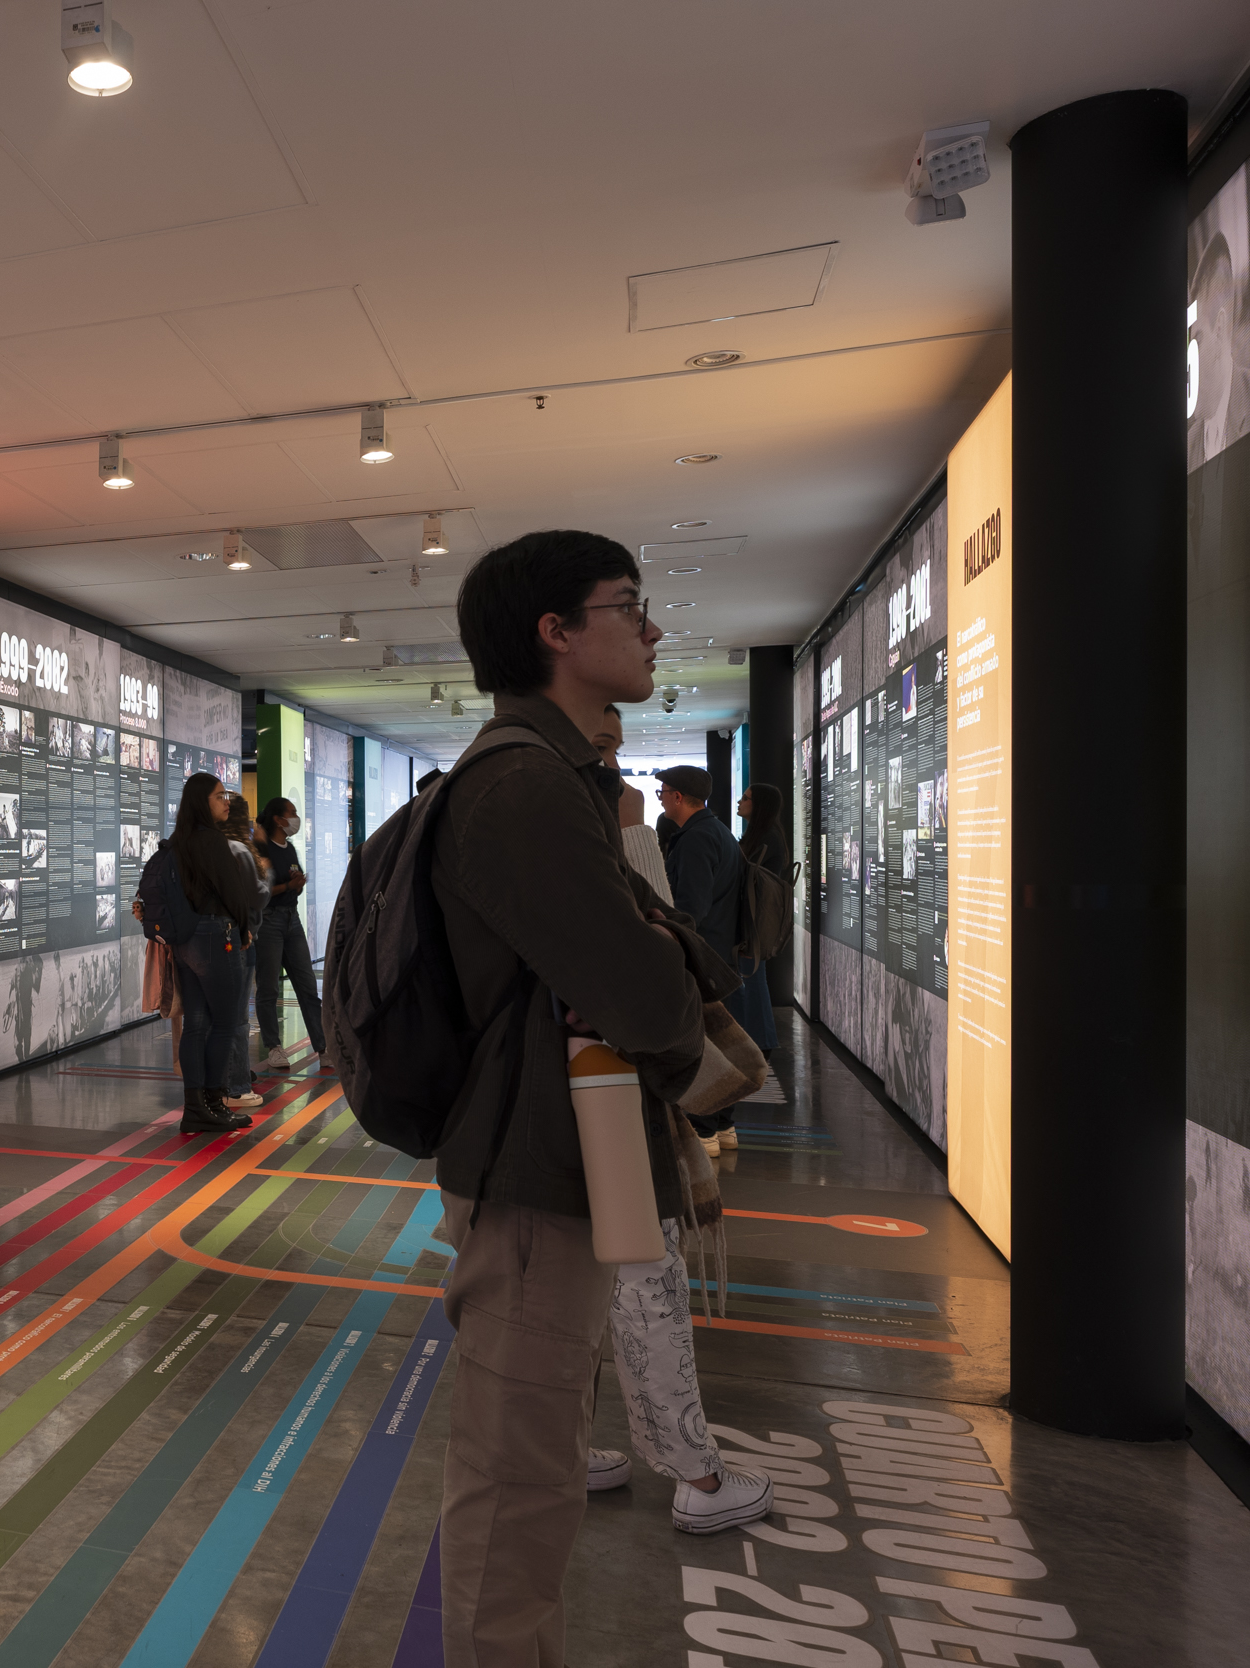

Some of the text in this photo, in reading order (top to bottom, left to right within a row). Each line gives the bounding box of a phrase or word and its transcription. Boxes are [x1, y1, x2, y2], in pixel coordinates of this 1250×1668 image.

[963, 507, 1001, 587] HALLAZGO
[957, 630, 961, 647] El
[957, 634, 995, 668] como protagonista
[964, 662, 981, 684] conflicto
[982, 653, 999, 675] armado
[0, 678, 19, 697] Éxodo
[957, 686, 984, 711] y factor de su
[119, 713, 134, 726] Proceso
[957, 706, 981, 732] persistencia
[820, 1294, 873, 1304] Patriota
[821, 1313, 877, 1322] Patriota
[7, 1340, 25, 1352] como
[824, 1333, 882, 1342] Patriota
[56, 1321, 130, 1381] Los entramados paramilitares
[151, 1330, 201, 1374] Modelo de seguridad
[319, 1376, 332, 1384] los
[306, 1383, 328, 1407] derechos
[385, 1357, 429, 1435] Por una democracia sin violencia
[290, 1407, 314, 1431] humanos
[265, 1435, 297, 1472] infracciones
[252, 1479, 270, 1493] DIH
[261, 1471, 275, 1479] al
[822, 1401, 1047, 1579] CUARTO
